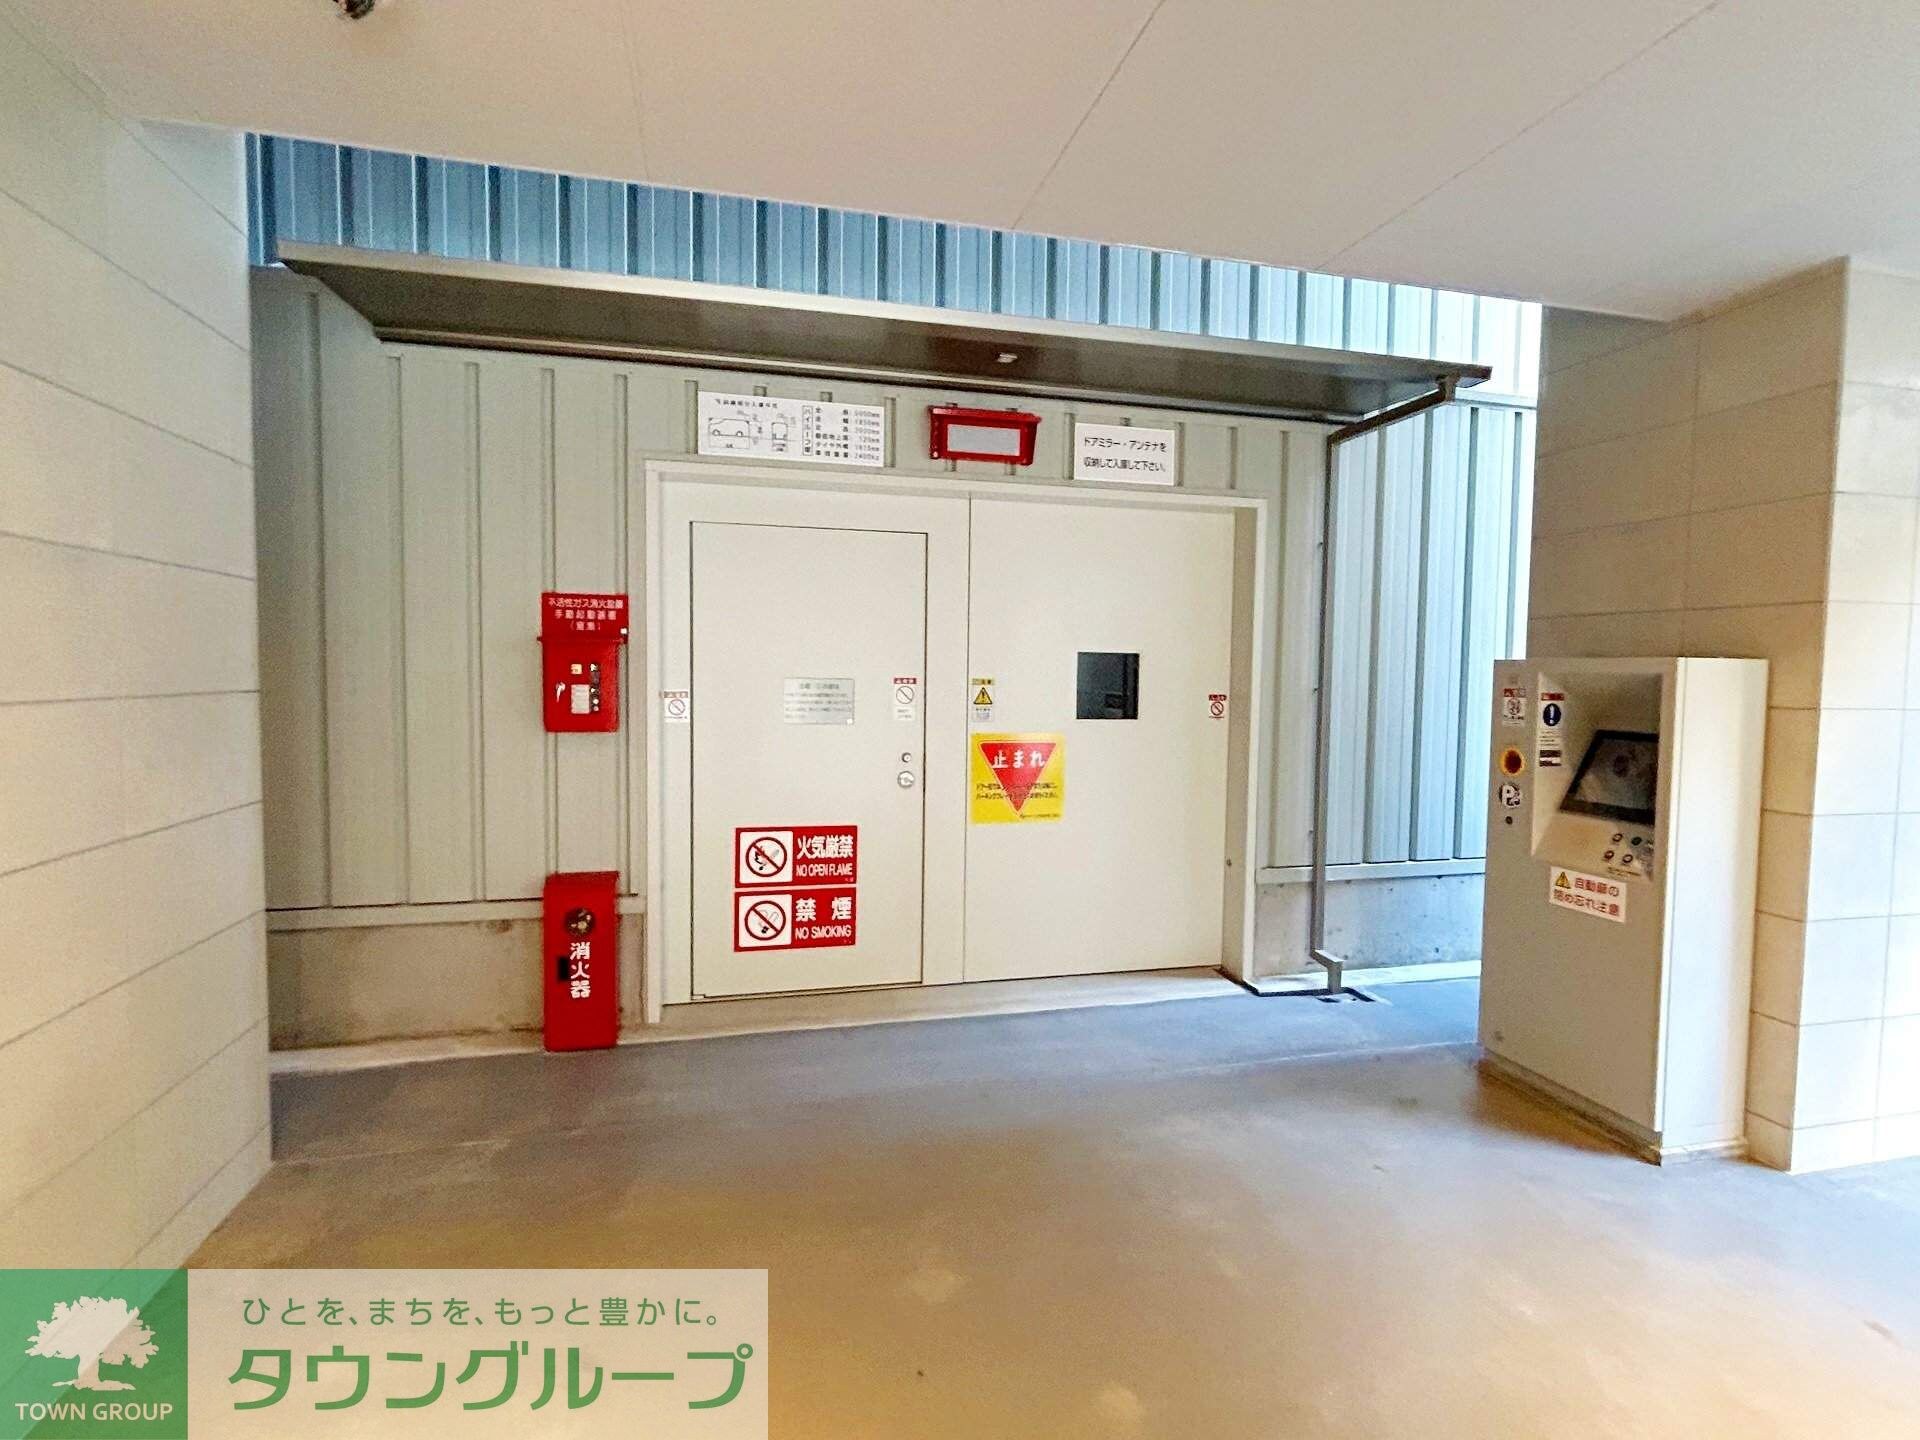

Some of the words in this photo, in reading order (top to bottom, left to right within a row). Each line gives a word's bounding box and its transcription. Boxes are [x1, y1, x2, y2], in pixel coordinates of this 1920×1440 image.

[991, 749, 1046, 769] 止まれ
[796, 834, 854, 859] 火気厳禁
[796, 864, 808, 877] NO
[808, 863, 829, 877] OPEN
[829, 862, 853, 876] FLAME
[795, 926, 809, 940] NO
[811, 924, 852, 939] SMOKING
[569, 941, 592, 999] 消火器
